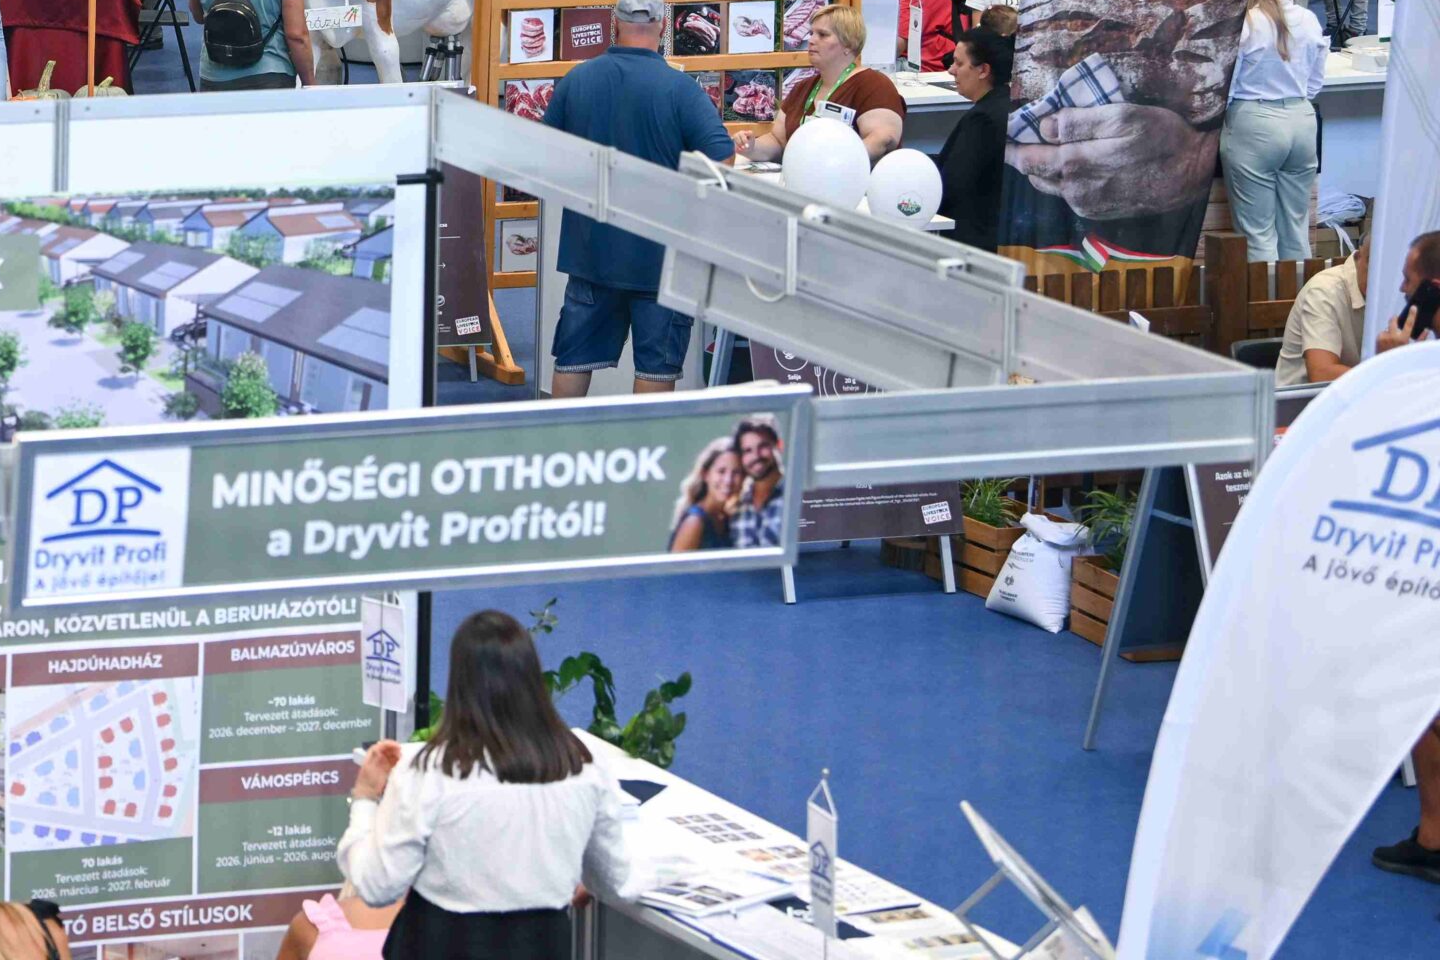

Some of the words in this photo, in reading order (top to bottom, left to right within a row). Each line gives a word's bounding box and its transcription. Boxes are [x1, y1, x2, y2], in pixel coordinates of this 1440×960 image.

[572, 24, 601, 33] EUROPEAN
[572, 30, 601, 39] LIVESTOCK
[574, 36, 602, 46] VOICE
[456, 316, 479, 324] EUROPEAN
[458, 325, 481, 335] VOICE
[211, 456, 421, 508] MINŐSÉGI
[431, 446, 667, 495] OTTHONOK
[1215, 470, 1232, 481] Azok
[70, 486, 143, 526] DP
[922, 502, 948, 511] EUROPEAN
[924, 507, 948, 516] LIVESTOCK
[925, 513, 950, 522] VOICE
[266, 527, 292, 557] a
[303, 511, 429, 560] Dryvit
[441, 500, 606, 545] Profitól!
[1311, 514, 1408, 559] Dryvit
[35, 545, 104, 571] Dryvit
[113, 542, 167, 563] Profi
[1302, 554, 1317, 572] A
[1323, 558, 1380, 585] jövő
[54, 609, 191, 635] KÖZVETLENÜL
[195, 610, 209, 626] A
[214, 597, 357, 623] BERUHÁZÓTÓL!
[230, 638, 356, 661] BALMAZÚJVÁROS
[372, 639, 396, 658] DP
[48, 653, 163, 674] HAJDÚHADHÁZ
[289, 693, 315, 706] lakás
[244, 710, 289, 722] Tervezett
[291, 706, 338, 719] átadások:
[209, 728, 234, 739] 2026.
[236, 723, 287, 736] december
[296, 722, 322, 732] 2027.
[323, 717, 372, 730] december
[241, 770, 339, 790] VÁMOSPÉRCS
[284, 824, 312, 836] lakás
[242, 839, 289, 852] Tervezett
[290, 835, 336, 849] átadások:
[81, 858, 95, 869] 70
[96, 856, 123, 867] lakás
[215, 855, 240, 867] 2026.
[243, 851, 274, 867] június
[281, 851, 310, 864] 2026.
[55, 872, 100, 884] Tervezett
[101, 867, 148, 880] átadások:
[31, 889, 58, 900] 2026.
[60, 884, 99, 897] március
[108, 881, 133, 892] 2027.
[134, 878, 171, 890] február
[92, 908, 155, 934] BELSŐ
[159, 903, 253, 928] STÍLUSOK
